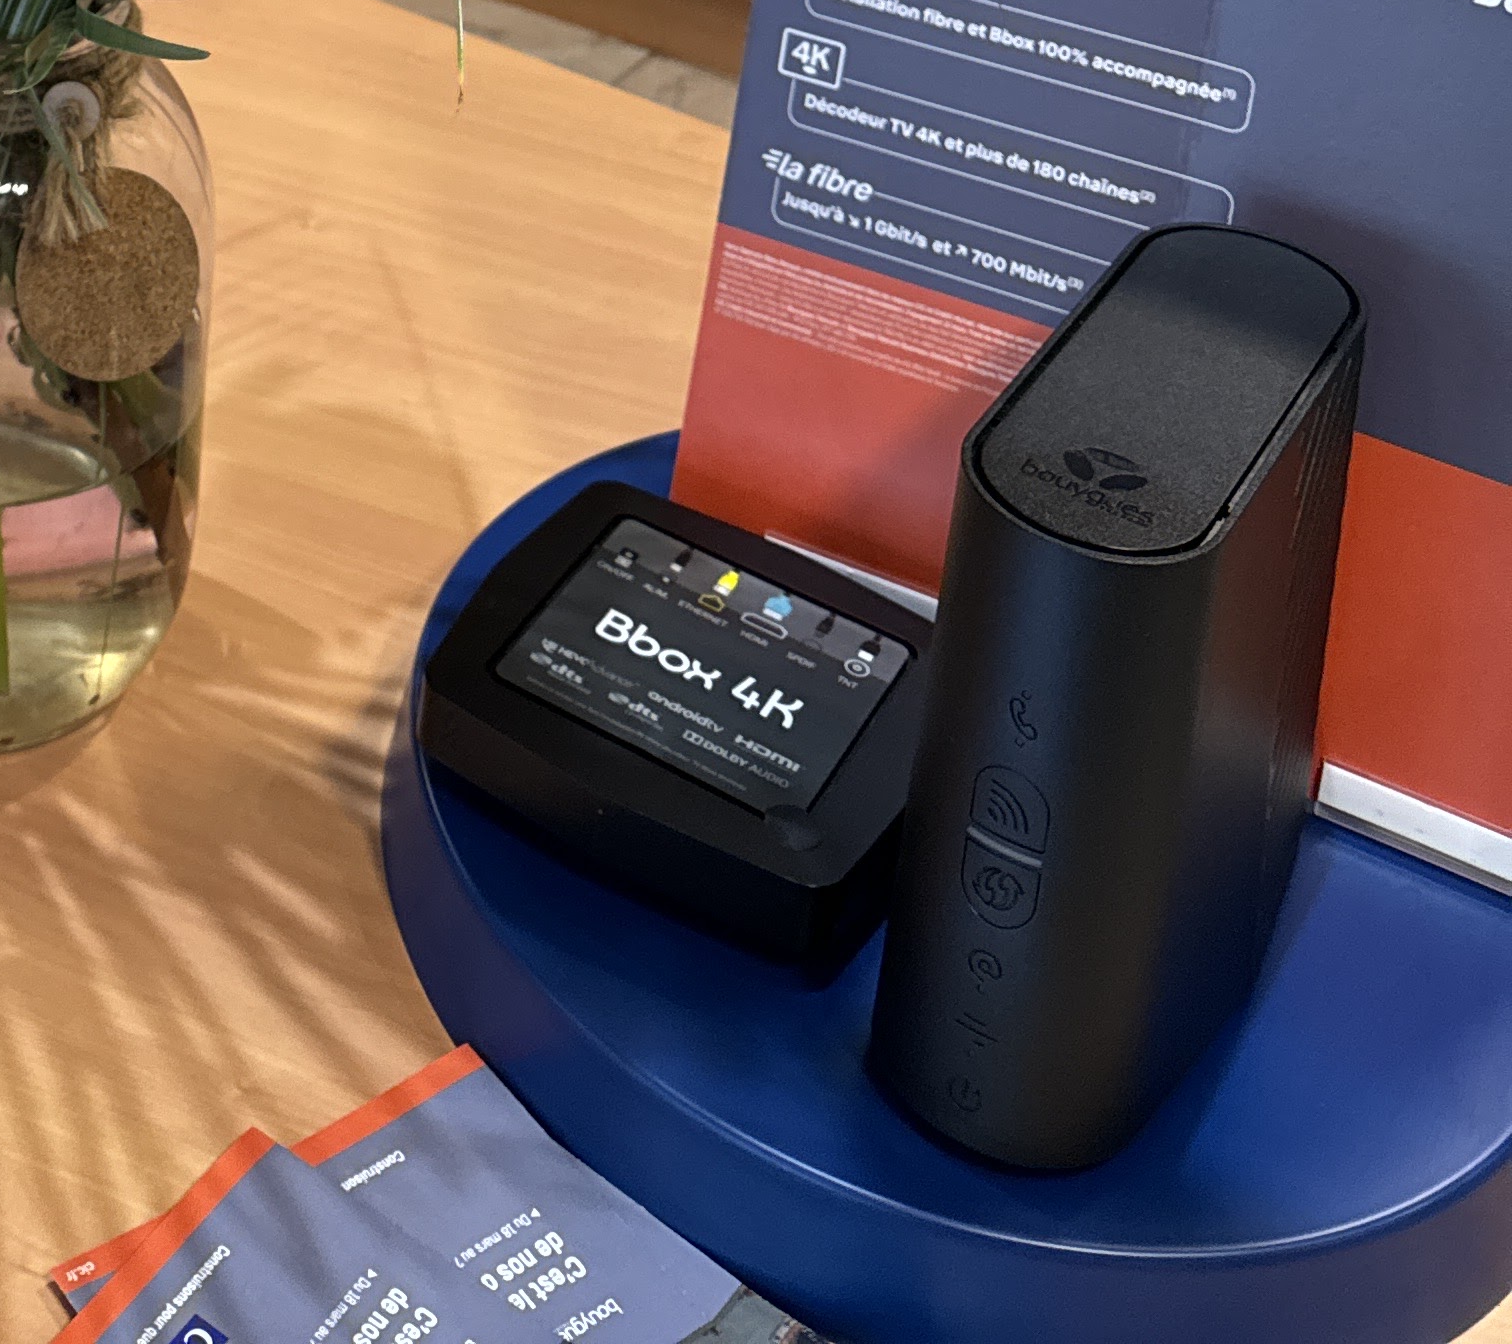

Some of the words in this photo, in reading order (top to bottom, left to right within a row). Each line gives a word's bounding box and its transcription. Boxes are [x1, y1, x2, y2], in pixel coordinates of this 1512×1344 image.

[923, 8, 965, 34] fibre
[967, 23, 988, 40] et
[989, 26, 1036, 52] Bbox
[1038, 40, 1089, 67] 100%
[791, 40, 831, 72] 4K
[803, 93, 889, 130] Décodeur
[890, 117, 915, 139] TV
[915, 125, 943, 147] 4K
[944, 136, 964, 154] et
[965, 142, 1005, 166] plus
[1006, 152, 1031, 174] de
[1032, 160, 1066, 183] 180
[777, 152, 806, 181] la
[807, 162, 874, 202] fibre
[781, 191, 846, 224] Jusqu'à
[864, 215, 874, 233] 1
[874, 219, 929, 250] Gbit/s
[931, 239, 953, 257] et
[970, 247, 1007, 274] 700
[594, 607, 723, 691] Bbox
[730, 676, 805, 730] 4K
[702, 739, 750, 768] DOLBY
[474, 1231, 502, 1253] mars
[534, 1231, 564, 1257] de
[172, 1244, 231, 1307] Construisons
[496, 1248, 538, 1282] nos
[527, 1255, 587, 1302] C'est
[343, 1290, 361, 1306] 18
[353, 1276, 372, 1293] Du
[380, 1287, 410, 1315] de
[507, 1288, 537, 1311] le
[153, 1302, 177, 1330] pour
[324, 1301, 349, 1329] mars
[314, 1324, 330, 1341] au
